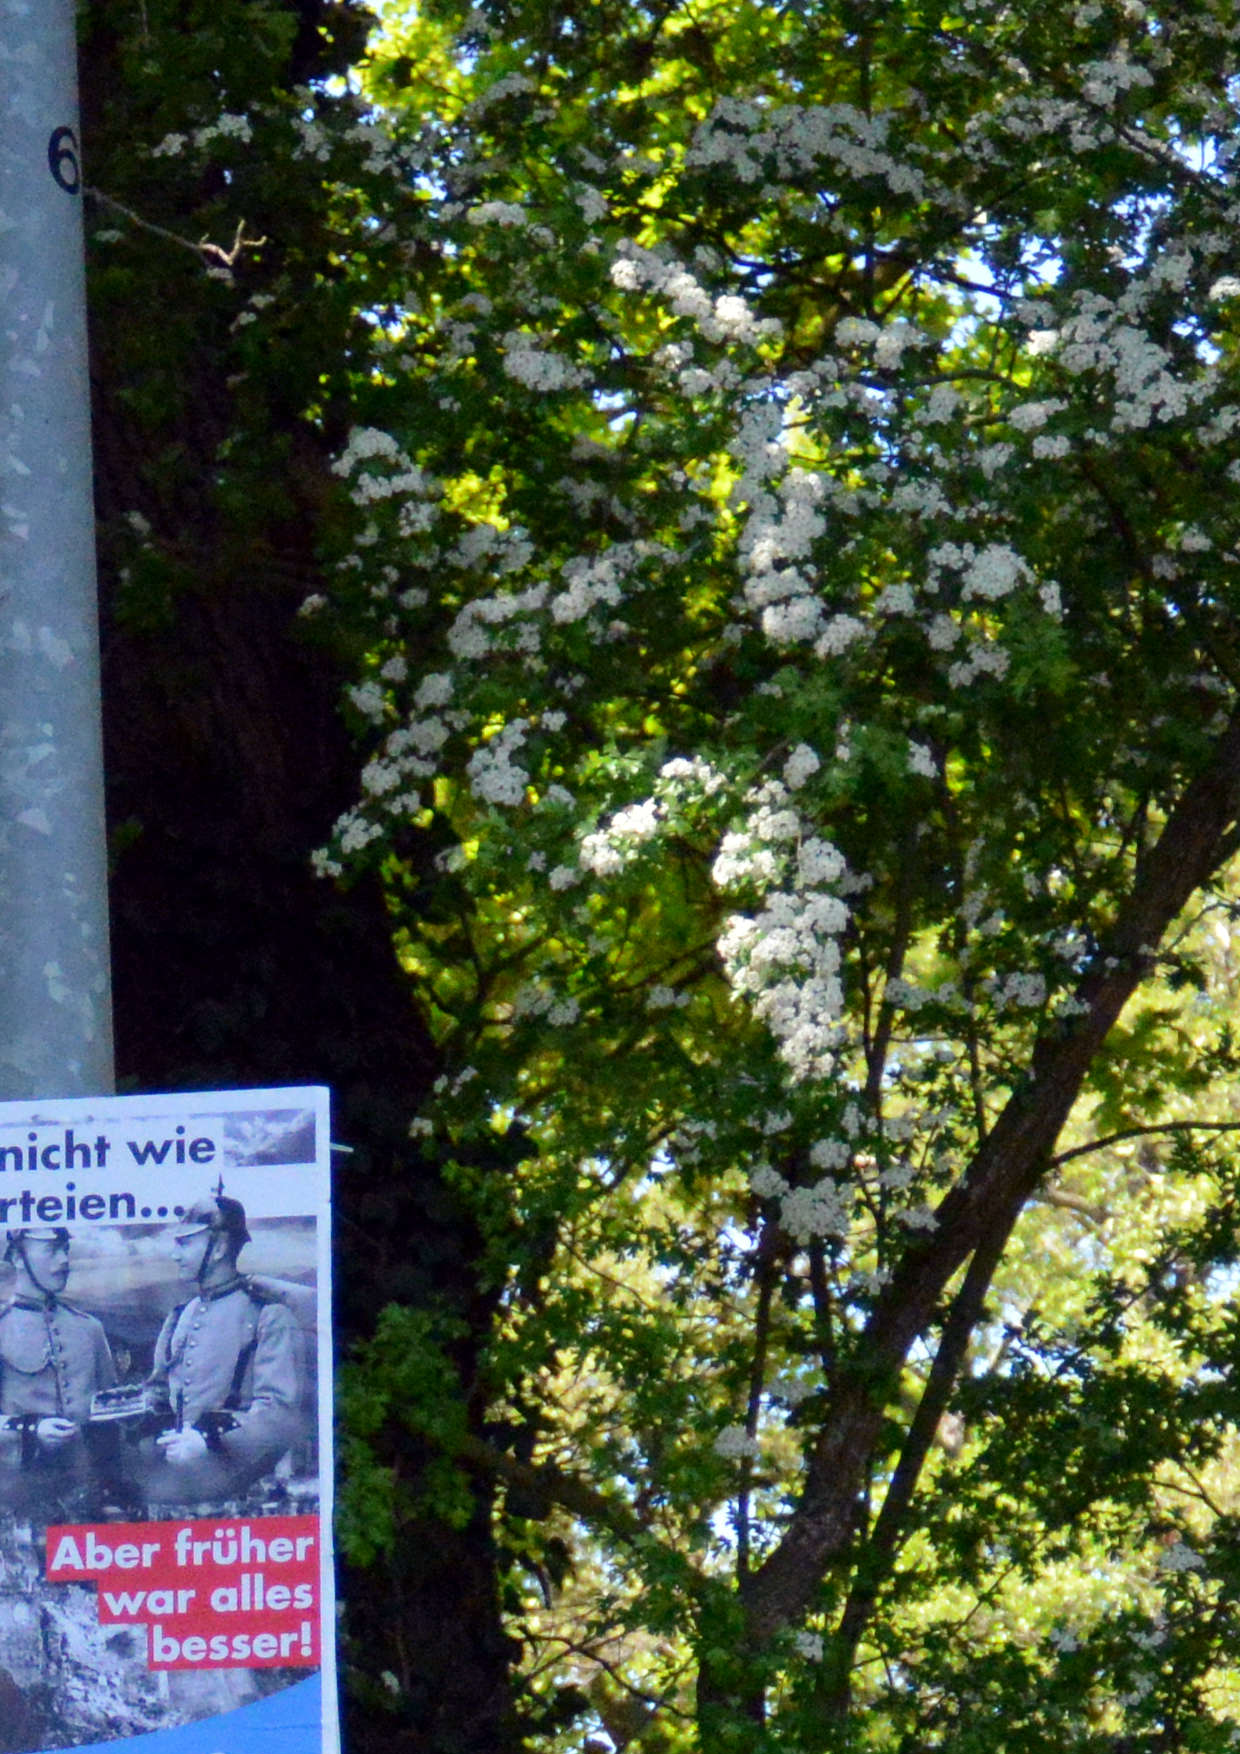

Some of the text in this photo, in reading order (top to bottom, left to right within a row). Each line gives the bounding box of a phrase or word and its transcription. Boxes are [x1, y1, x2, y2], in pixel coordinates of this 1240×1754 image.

[48, 126, 80, 196] 6
[126, 1125, 216, 1165] wie
[50, 1525, 314, 1571] Aber früher
[103, 1573, 313, 1616] war alles
[152, 1620, 312, 1662] besser!
